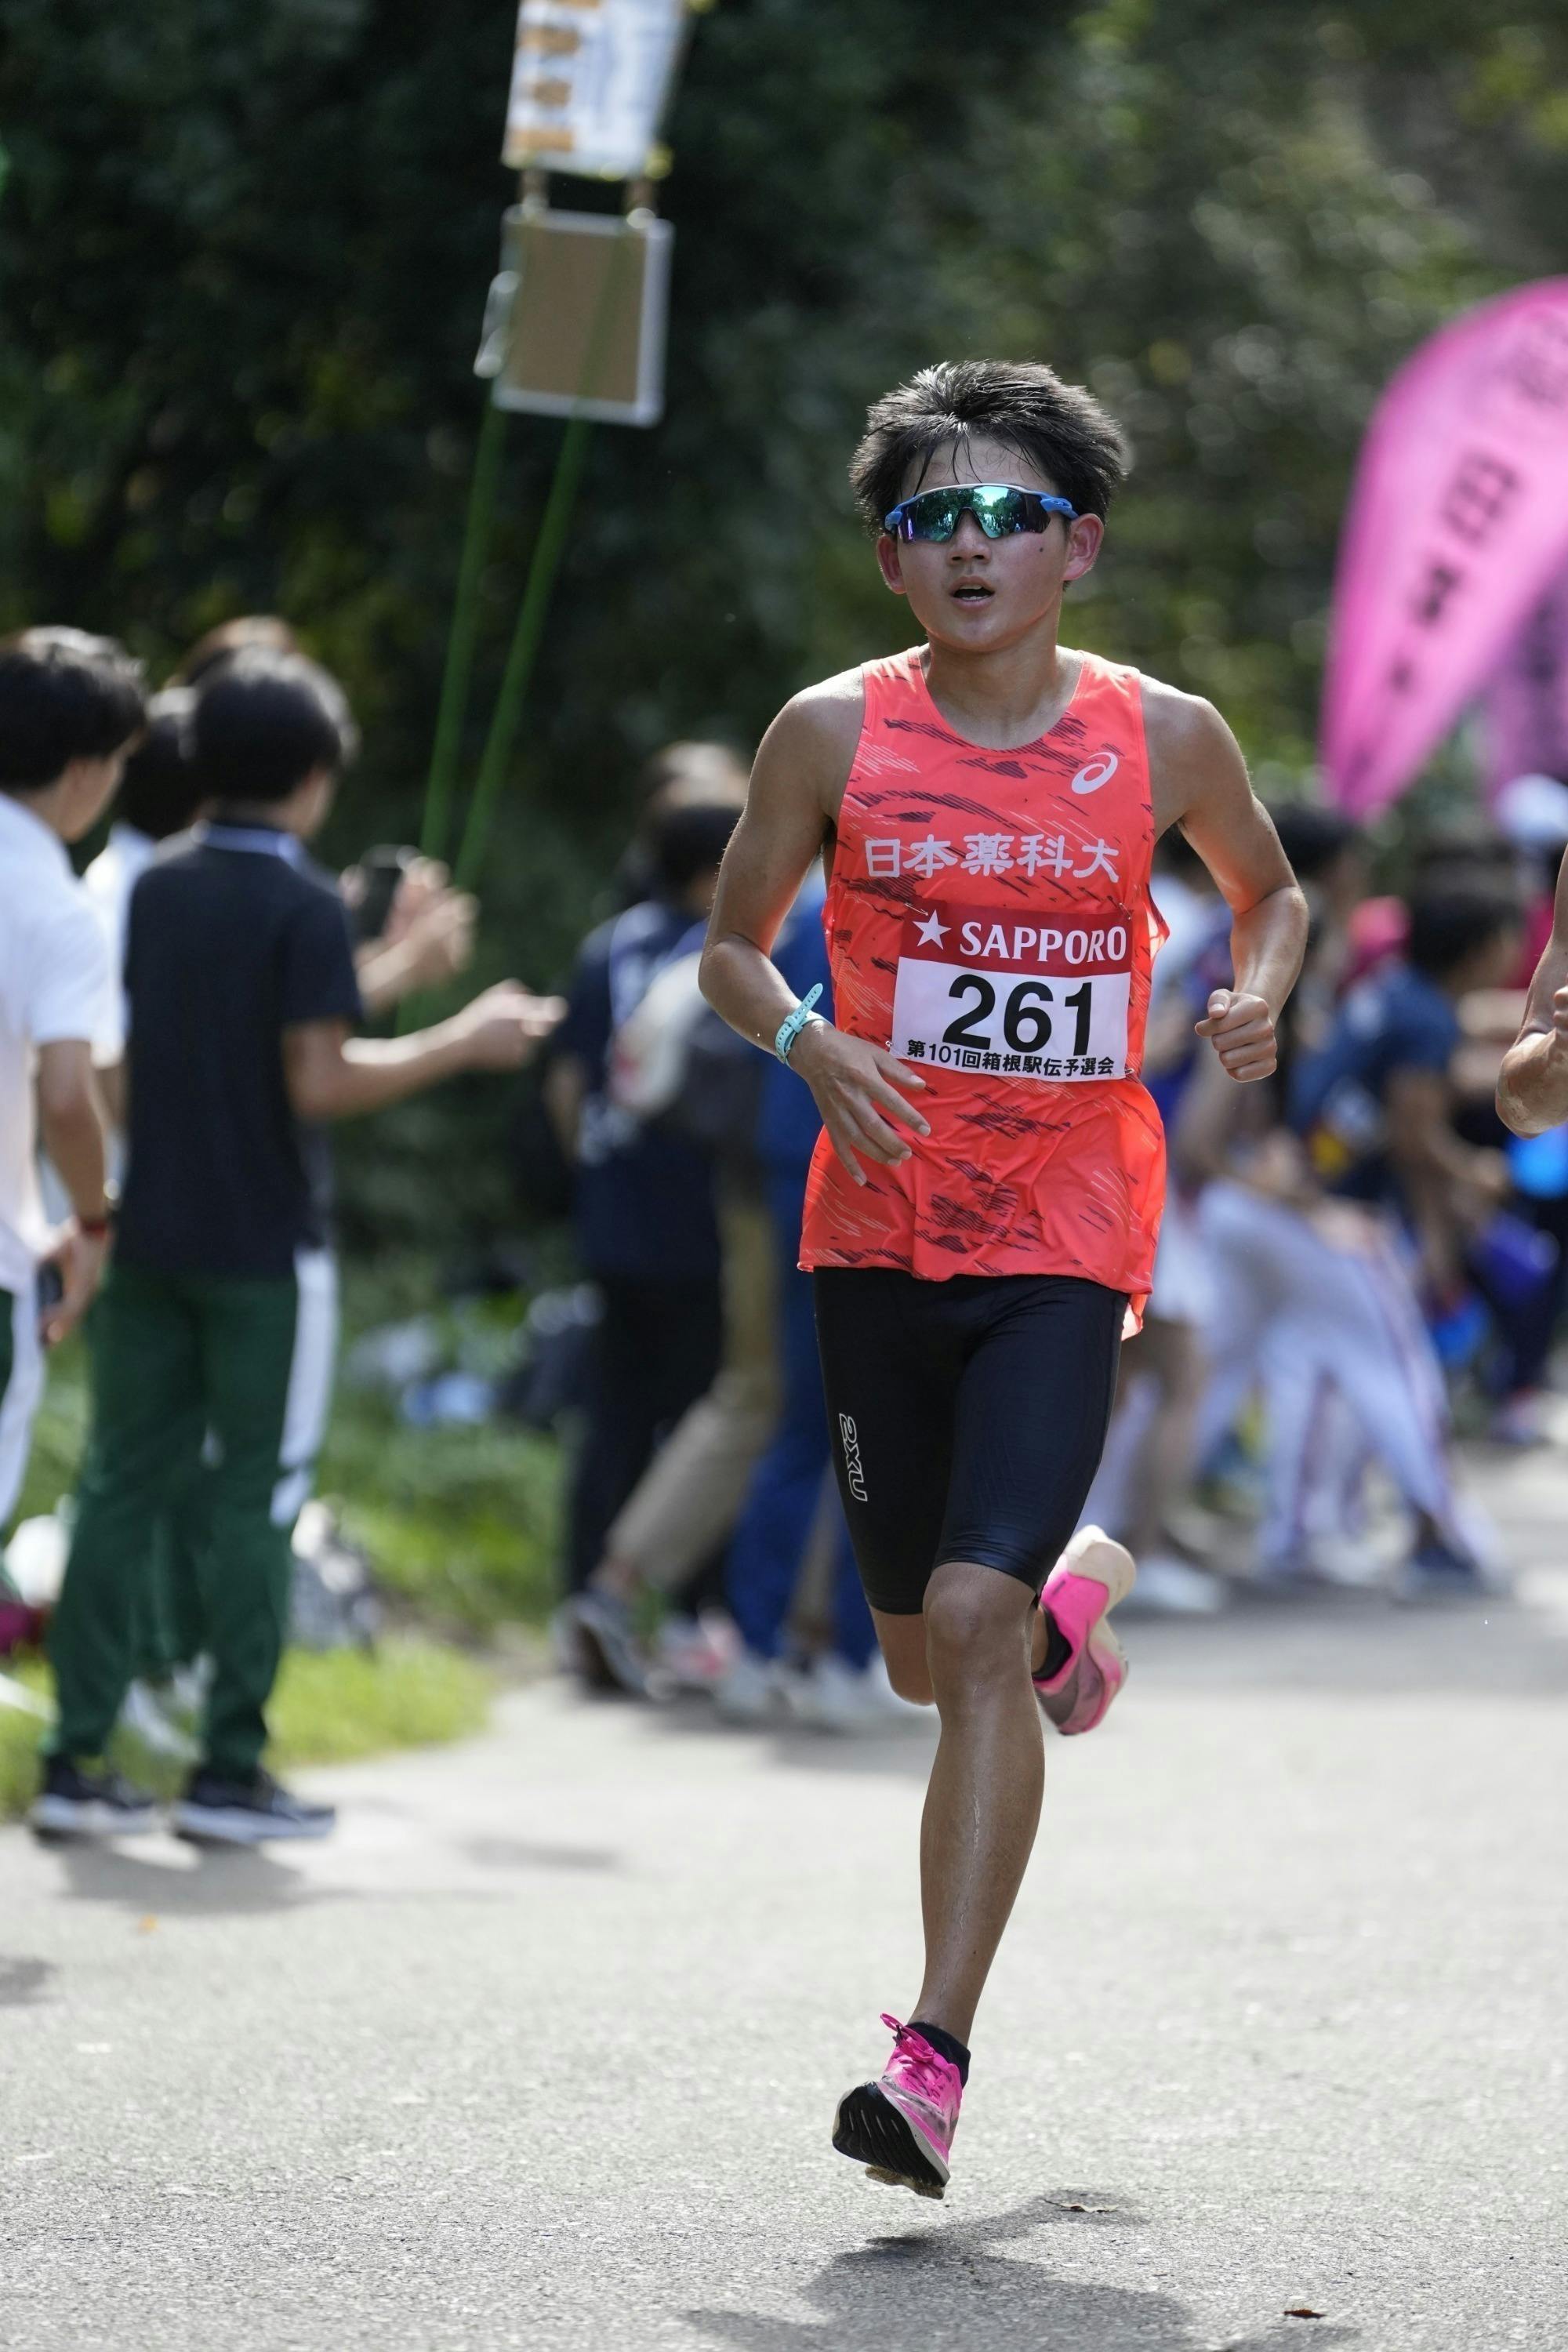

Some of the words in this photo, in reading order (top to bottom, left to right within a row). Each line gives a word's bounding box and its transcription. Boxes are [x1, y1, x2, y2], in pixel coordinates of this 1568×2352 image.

[865, 833, 1120, 883] 日本薬科大
[960, 921, 1127, 964] SAPPORO
[942, 974, 1093, 1056] 261
[906, 1039, 1115, 1076] 第101回箱根駅伝予選会
[839, 1413, 868, 1501] 2XU
